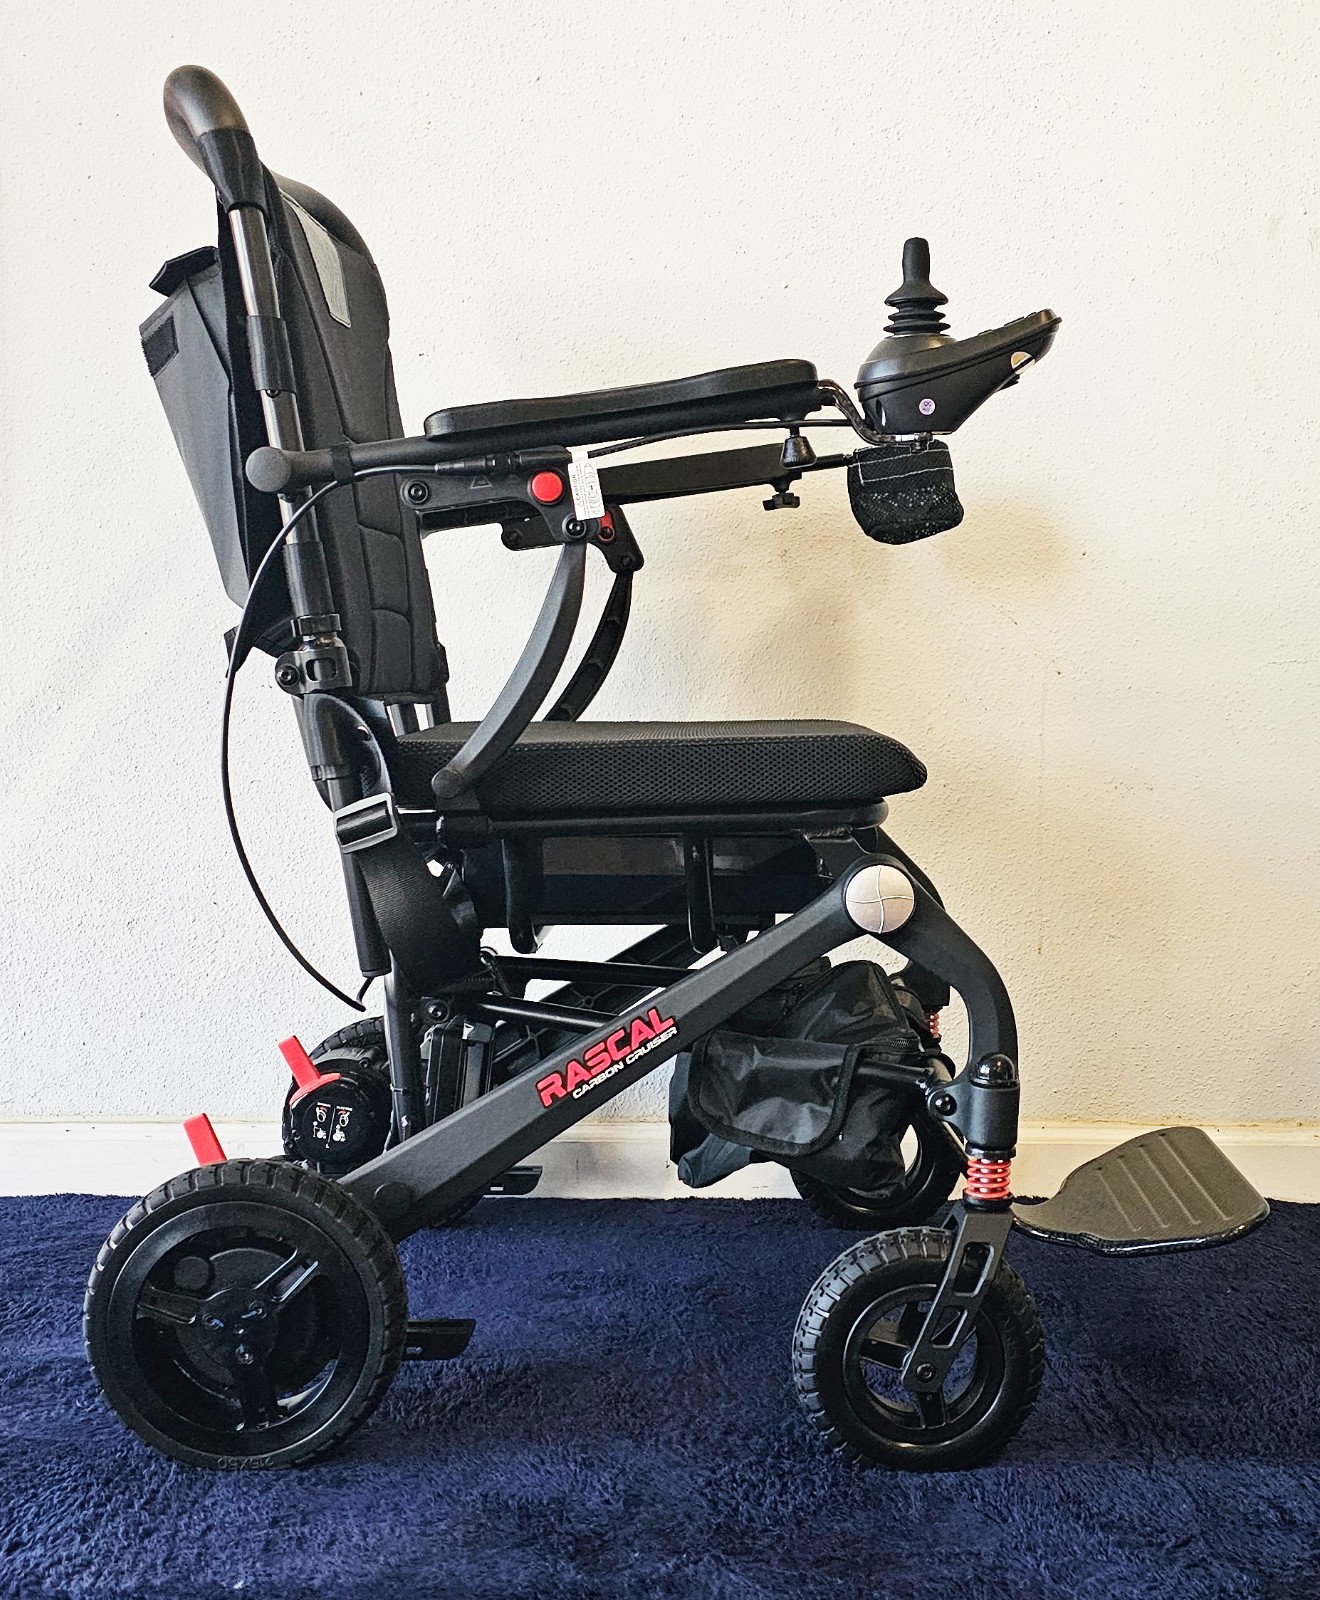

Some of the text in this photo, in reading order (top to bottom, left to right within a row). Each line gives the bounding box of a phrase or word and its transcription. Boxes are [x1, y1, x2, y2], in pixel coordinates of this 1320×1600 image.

[572, 474, 580, 500] CAUTION
[536, 1007, 675, 1107] RASCAL
[572, 1026, 677, 1099] CARBON CRUISER
